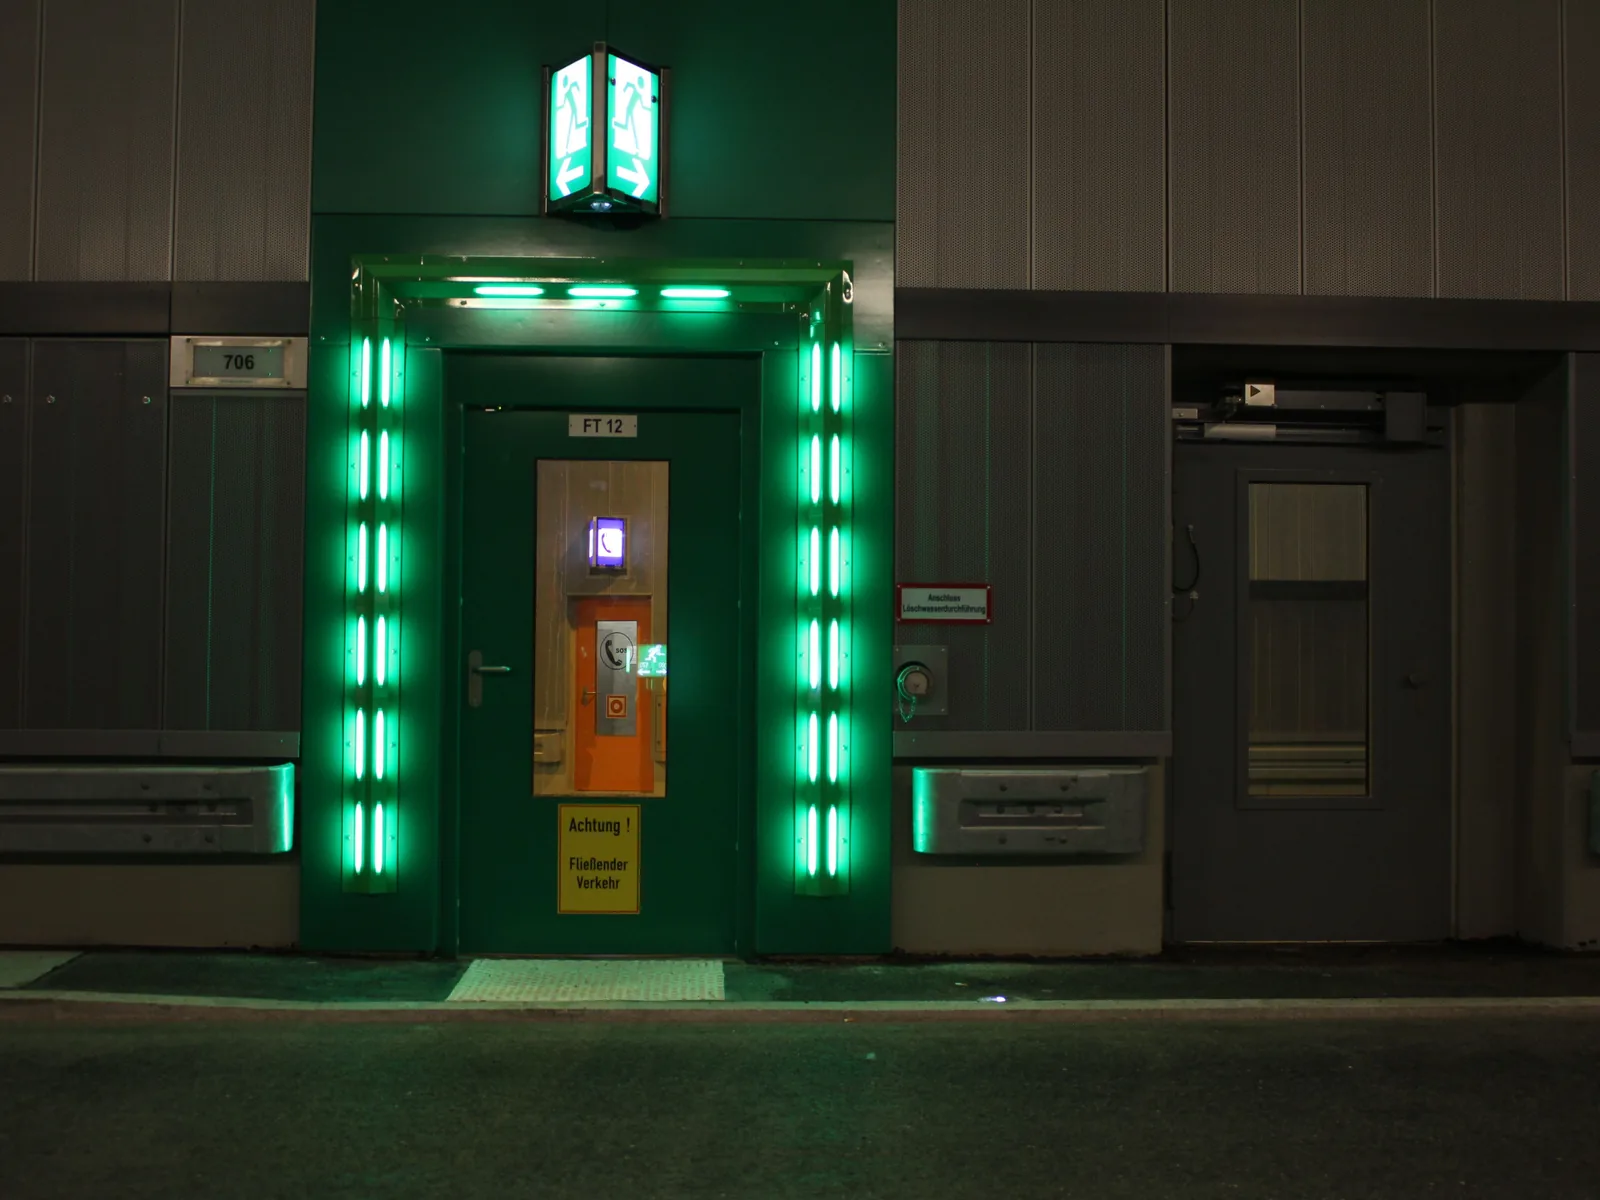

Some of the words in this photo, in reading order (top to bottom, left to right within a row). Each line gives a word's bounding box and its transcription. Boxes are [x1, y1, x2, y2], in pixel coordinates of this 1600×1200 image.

[223, 354, 255, 370] 706
[583, 418, 602, 433] FT
[607, 418, 623, 433] 12
[927, 593, 961, 602] Anschluss
[569, 817, 621, 836] Achtung
[569, 857, 629, 871] Fließender
[576, 875, 621, 890] Verkehr
